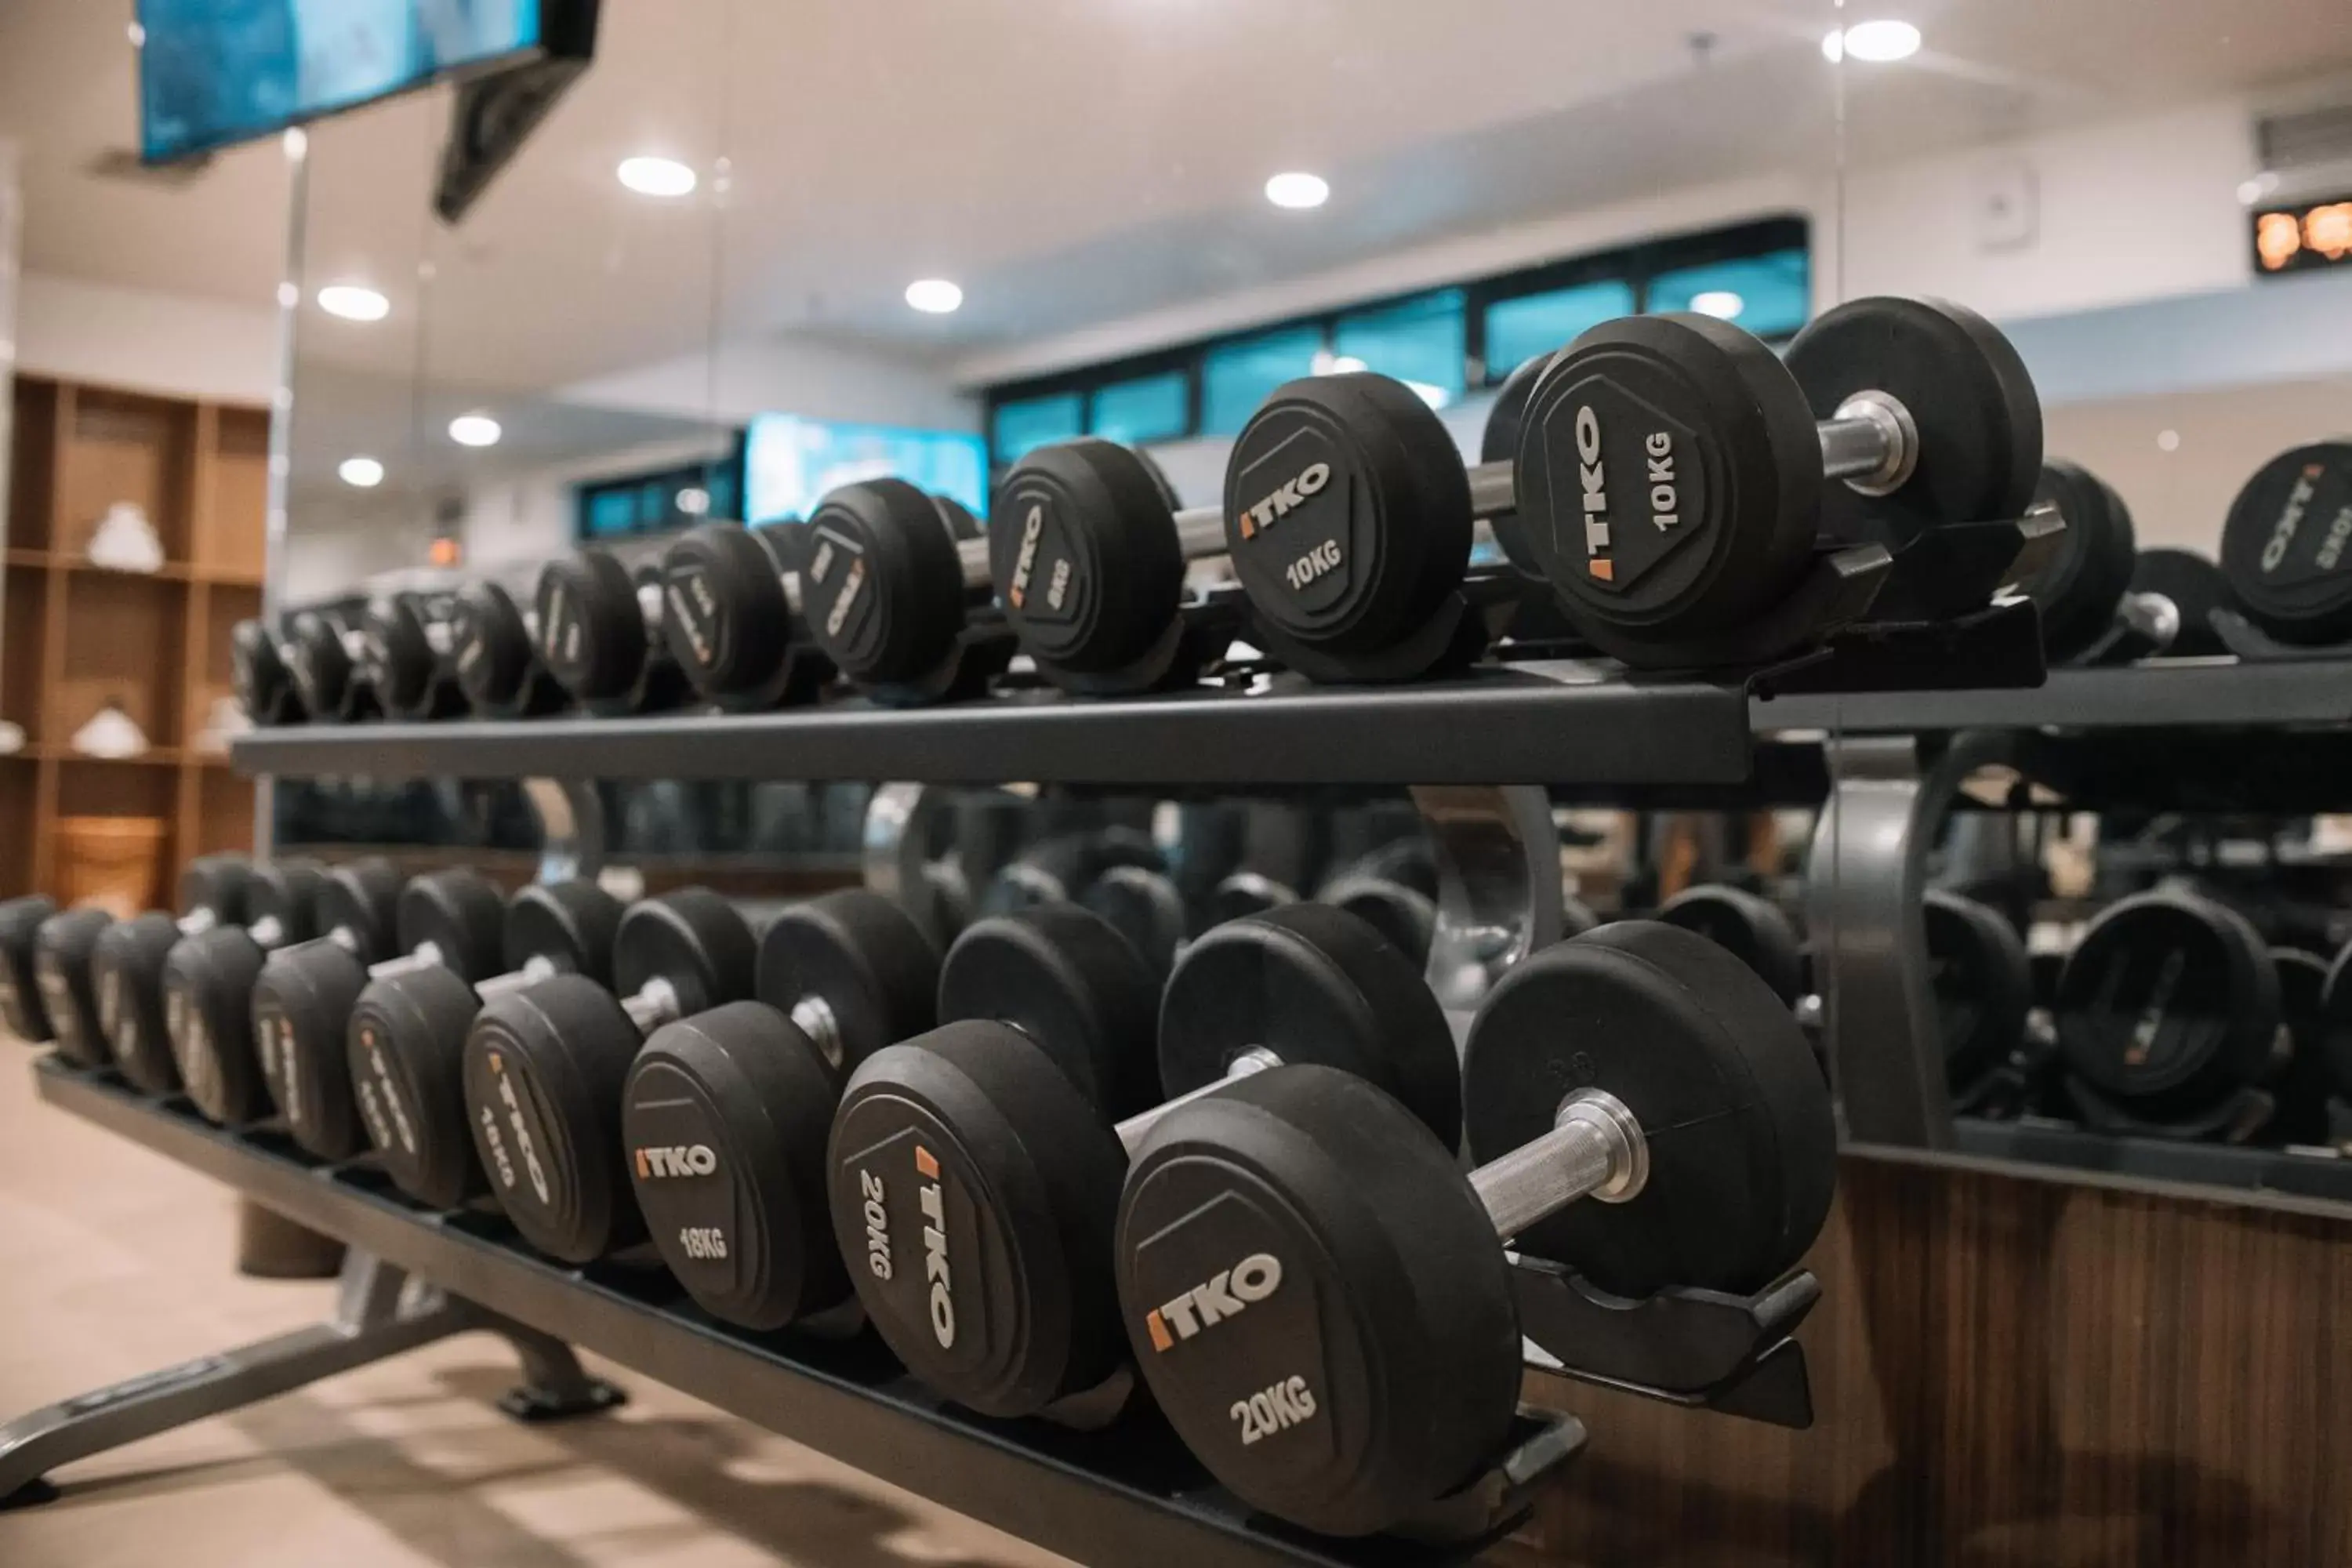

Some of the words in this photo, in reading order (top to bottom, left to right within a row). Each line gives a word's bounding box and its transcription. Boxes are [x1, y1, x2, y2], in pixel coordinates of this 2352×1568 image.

[1250, 461, 1330, 531] TKO
[1576, 405, 1610, 554] TKO
[1646, 432, 1679, 532] 10KG
[1286, 539, 1341, 590] 10KG
[645, 1144, 717, 1177] TKO
[680, 1227, 728, 1258] 18KG
[860, 1168, 892, 1281] 20KG
[920, 1183, 955, 1348] TKO
[1163, 1253, 1282, 1341] TKO
[1230, 1375, 1316, 1445] 20KG
